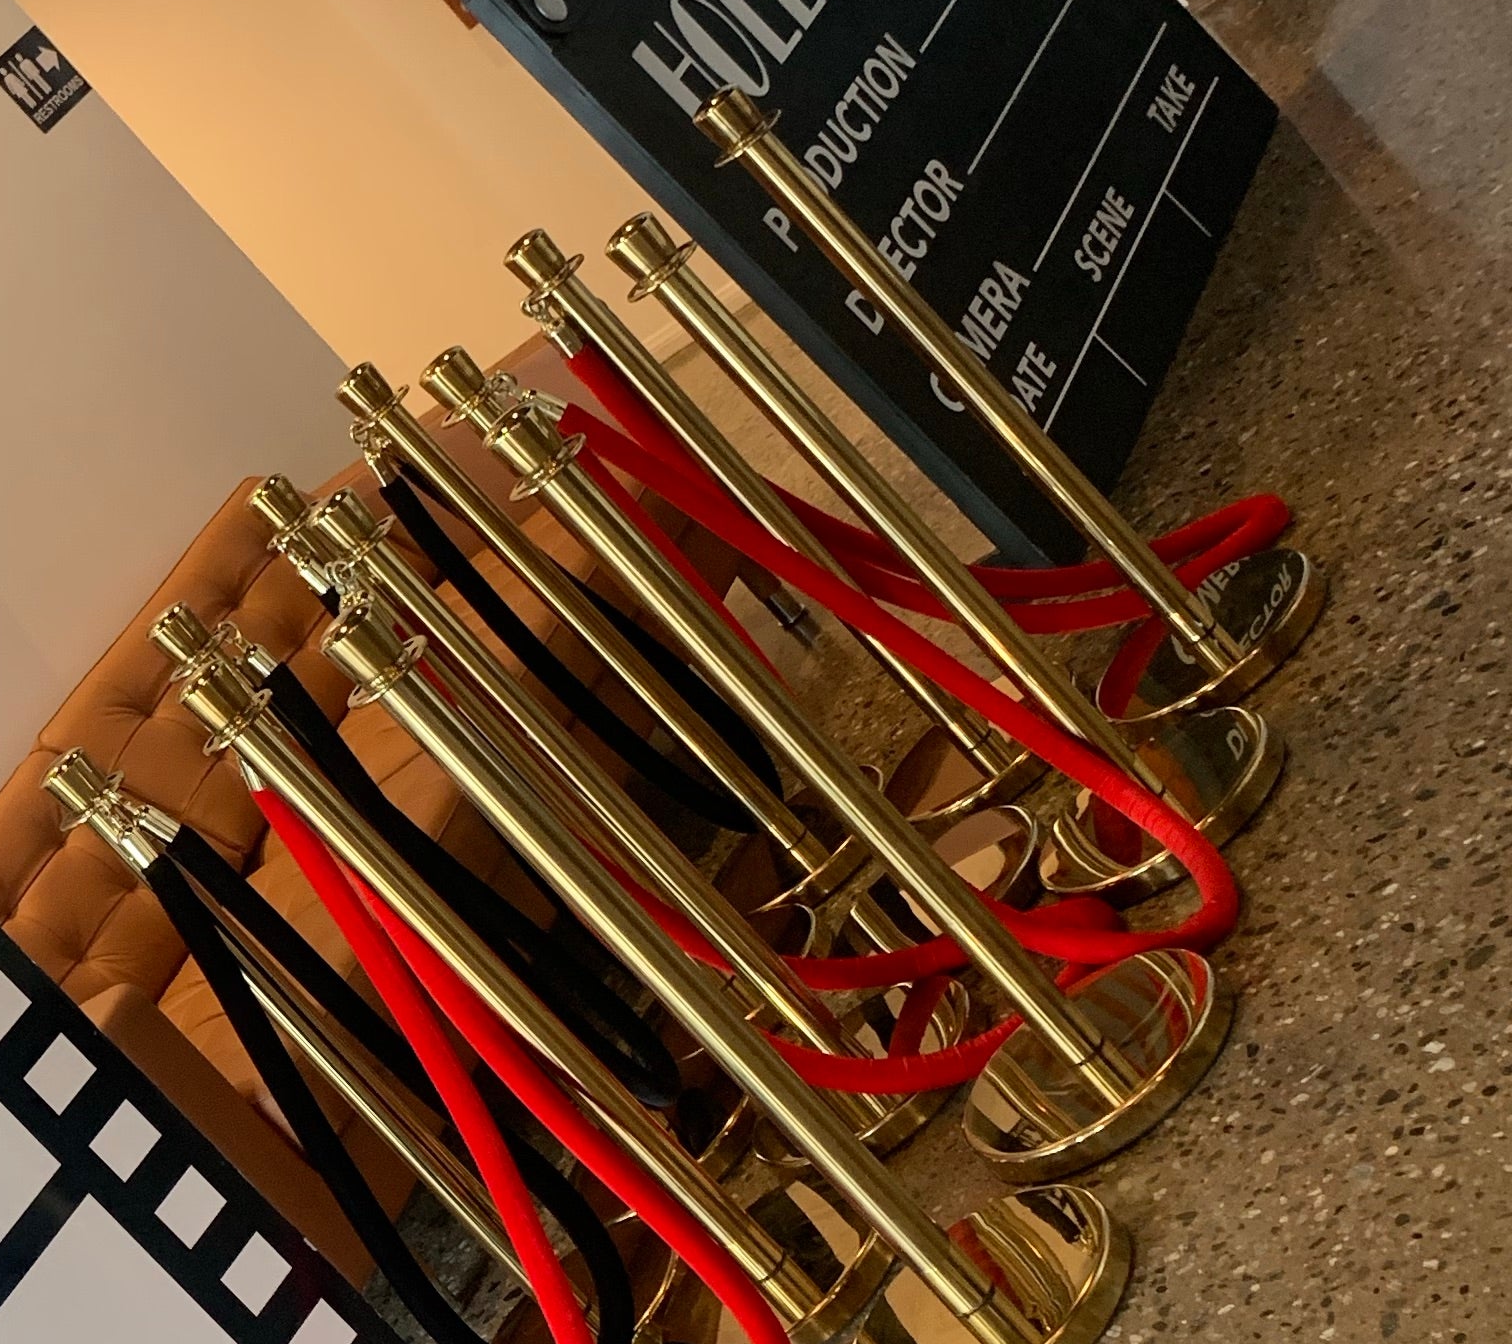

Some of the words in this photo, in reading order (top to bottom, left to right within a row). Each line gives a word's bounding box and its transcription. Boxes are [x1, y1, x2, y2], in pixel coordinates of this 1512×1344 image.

[32, 74, 85, 125] RESTROOMS
[762, 31, 917, 253] PDUCTION
[844, 158, 964, 336] DECTOR
[1009, 341, 1058, 415] ATE
[1074, 186, 1136, 283] SCENE
[1146, 63, 1196, 134] TAKE
[929, 260, 1031, 413] CMERA
